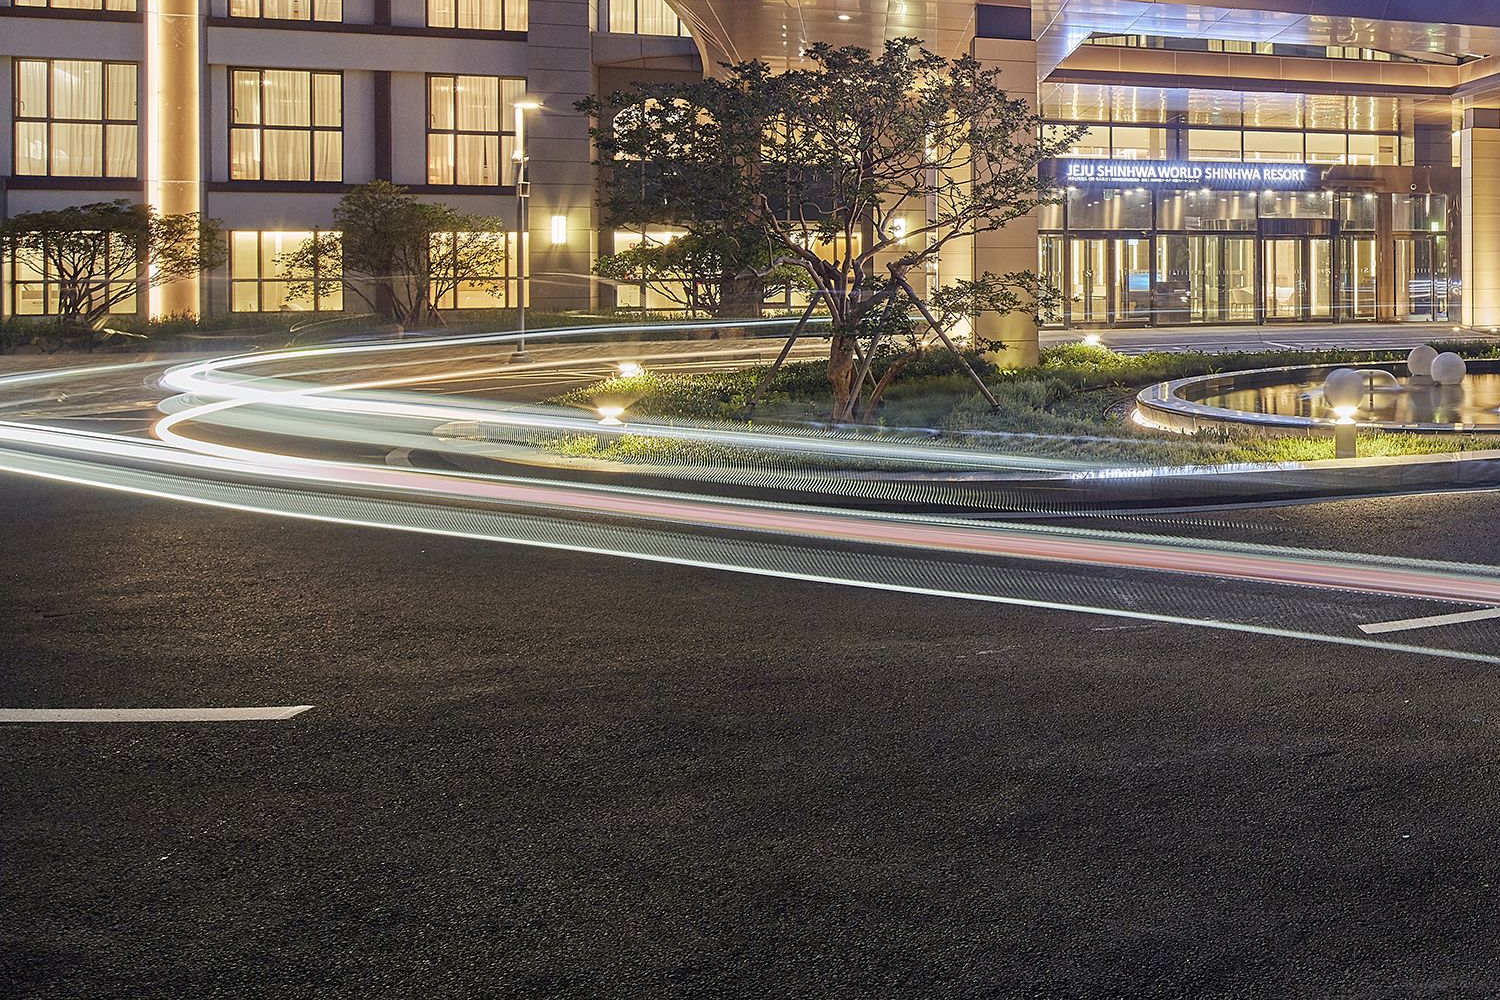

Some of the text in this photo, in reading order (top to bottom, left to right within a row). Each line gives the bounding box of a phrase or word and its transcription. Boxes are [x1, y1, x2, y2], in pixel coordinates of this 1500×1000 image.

[1066, 164, 1094, 177] JEJU
[1096, 165, 1156, 178] SHINHWA
[1157, 166, 1201, 179] WORLD
[1204, 167, 1261, 180] SHINHWA
[1263, 168, 1307, 181] RESORT
